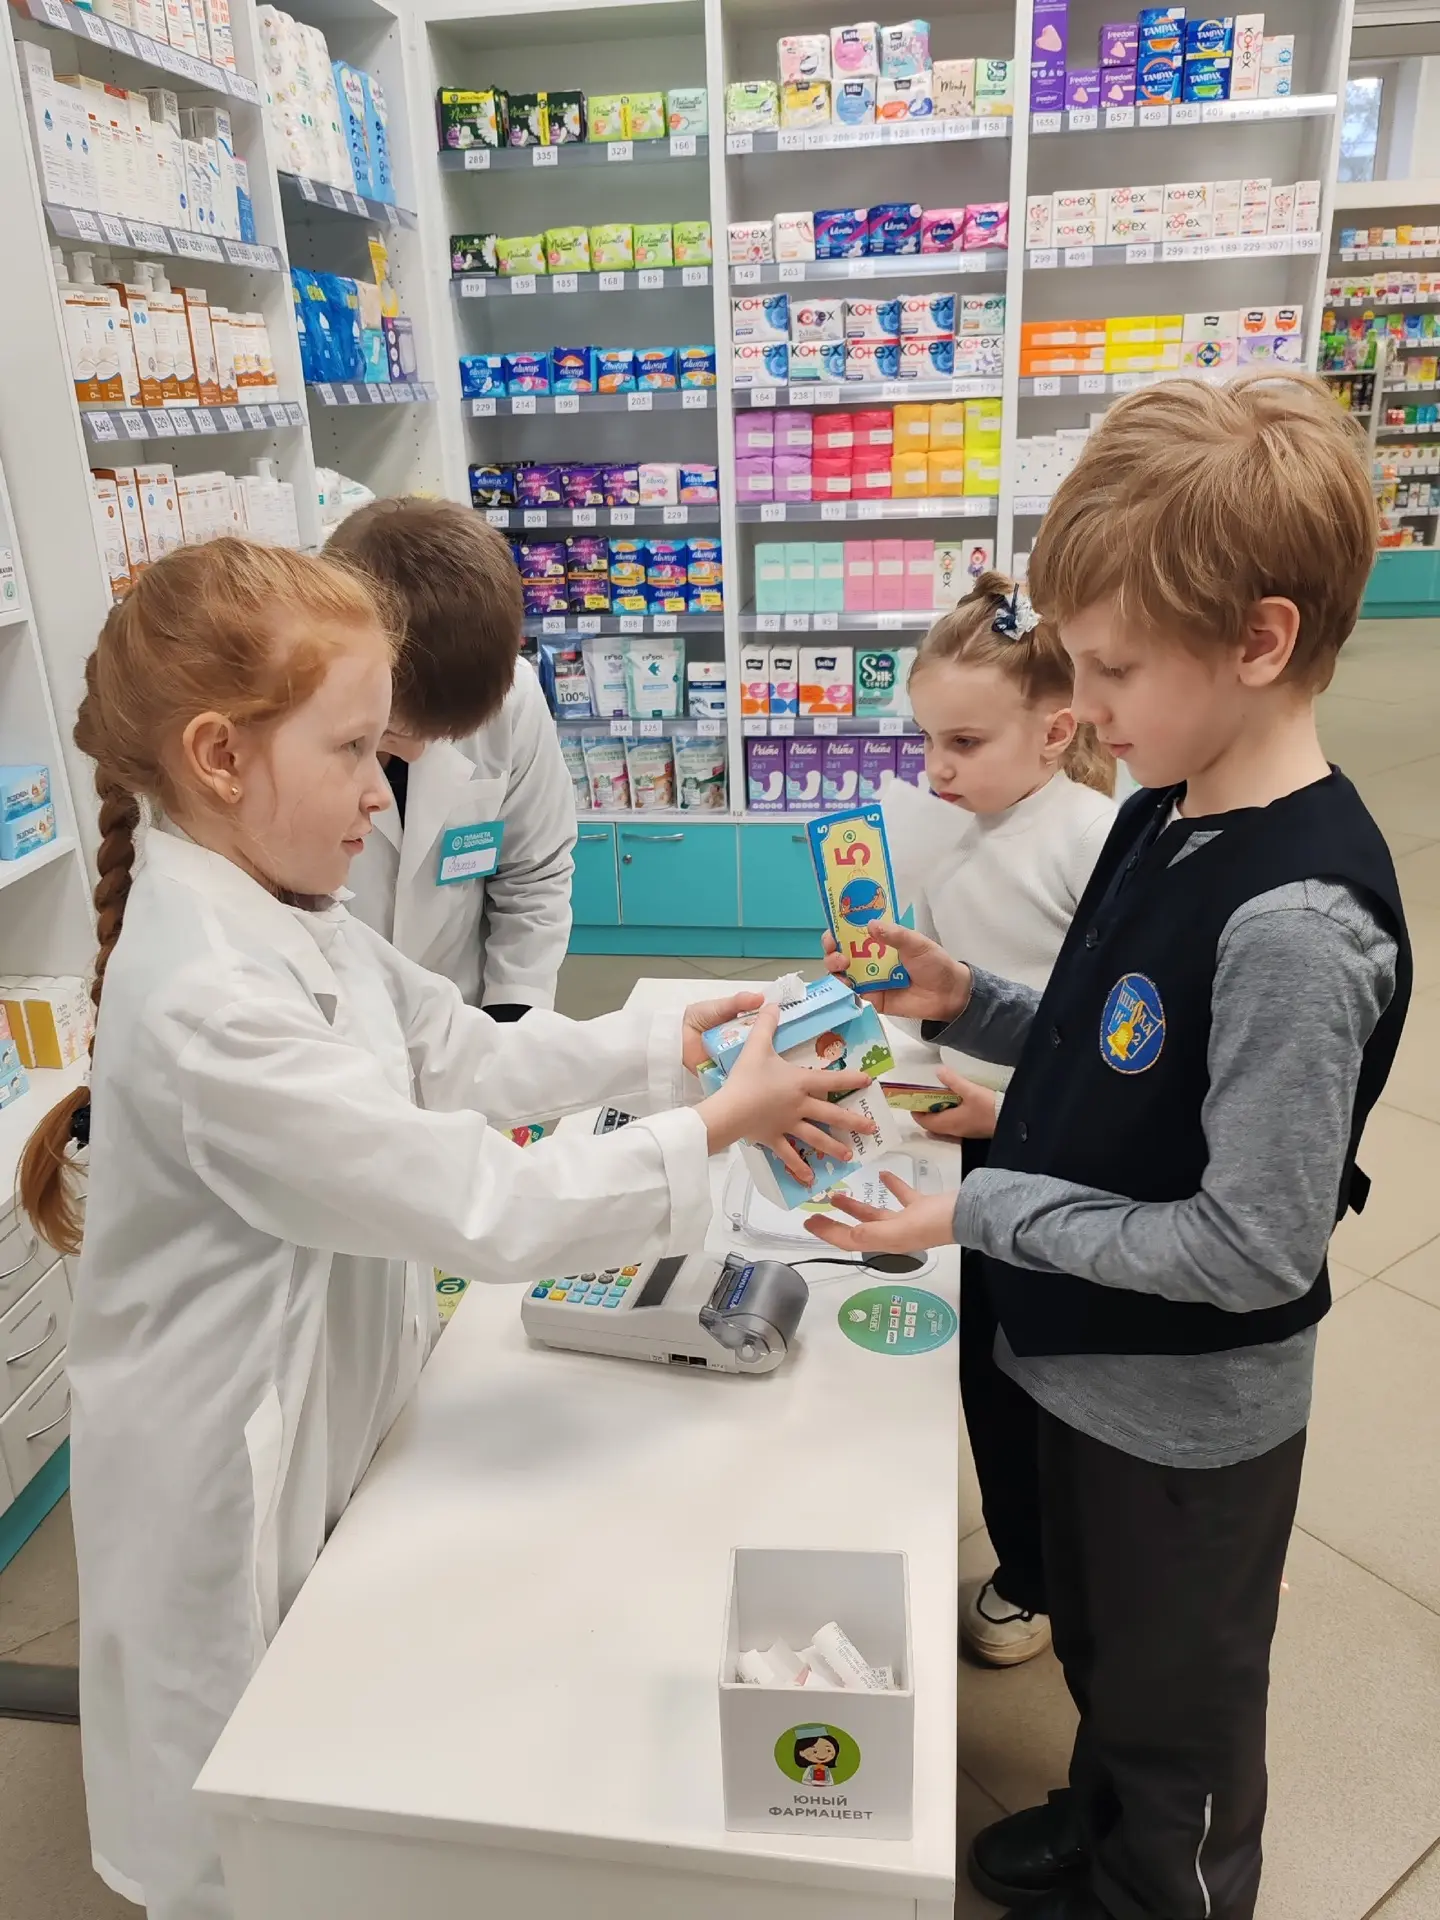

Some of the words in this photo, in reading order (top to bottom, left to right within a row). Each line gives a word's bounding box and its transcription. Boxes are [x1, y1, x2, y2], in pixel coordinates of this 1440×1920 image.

[1142, 22, 1178, 36] TAMPAX
[1197, 28, 1225, 39] TAMPAX
[1107, 30, 1135, 40] freedom
[1069, 75, 1098, 85] freedom
[1104, 72, 1133, 83] freedom
[1142, 70, 1175, 83] TAMPAX
[1190, 71, 1222, 84] TAMPAX
[1110, 112, 1127, 121] 657
[782, 136, 798, 144] 125
[536, 152, 552, 161] 335
[611, 147, 627, 156] 329
[468, 155, 484, 164] 289
[1166, 246, 1183, 255] 299
[641, 275, 657, 284] 189
[739, 270, 754, 279] 149
[465, 284, 480, 292] 189
[515, 280, 530, 289] 159
[556, 279, 572, 288] 185
[513, 364, 539, 375] always
[642, 362, 668, 373] always
[683, 359, 709, 371] always
[560, 367, 584, 379] always
[685, 396, 701, 404] 214
[475, 403, 491, 412] 229
[515, 401, 530, 410] 214
[95, 418, 110, 432] 649
[614, 512, 629, 521] 219
[666, 511, 682, 520] 229
[765, 508, 780, 517] 119
[526, 515, 542, 524] 209
[615, 552, 637, 562] always
[653, 553, 677, 563] always
[692, 550, 718, 560] always
[616, 587, 639, 596] always
[655, 589, 680, 599] always
[764, 619, 775, 627] 95
[793, 618, 803, 626] 95
[816, 659, 834, 669] bella
[560, 691, 590, 703] 100%
[867, 812, 881, 822] 5
[817, 824, 828, 834] 5
[834, 842, 871, 867] 5
[849, 937, 887, 960] 5
[892, 972, 904, 980] 5
[440, 1279, 463, 1293] 10
[793, 1794, 848, 1807] ЮНЫЙ
[768, 1806, 873, 1820] ФАРМАЦЕВТ
